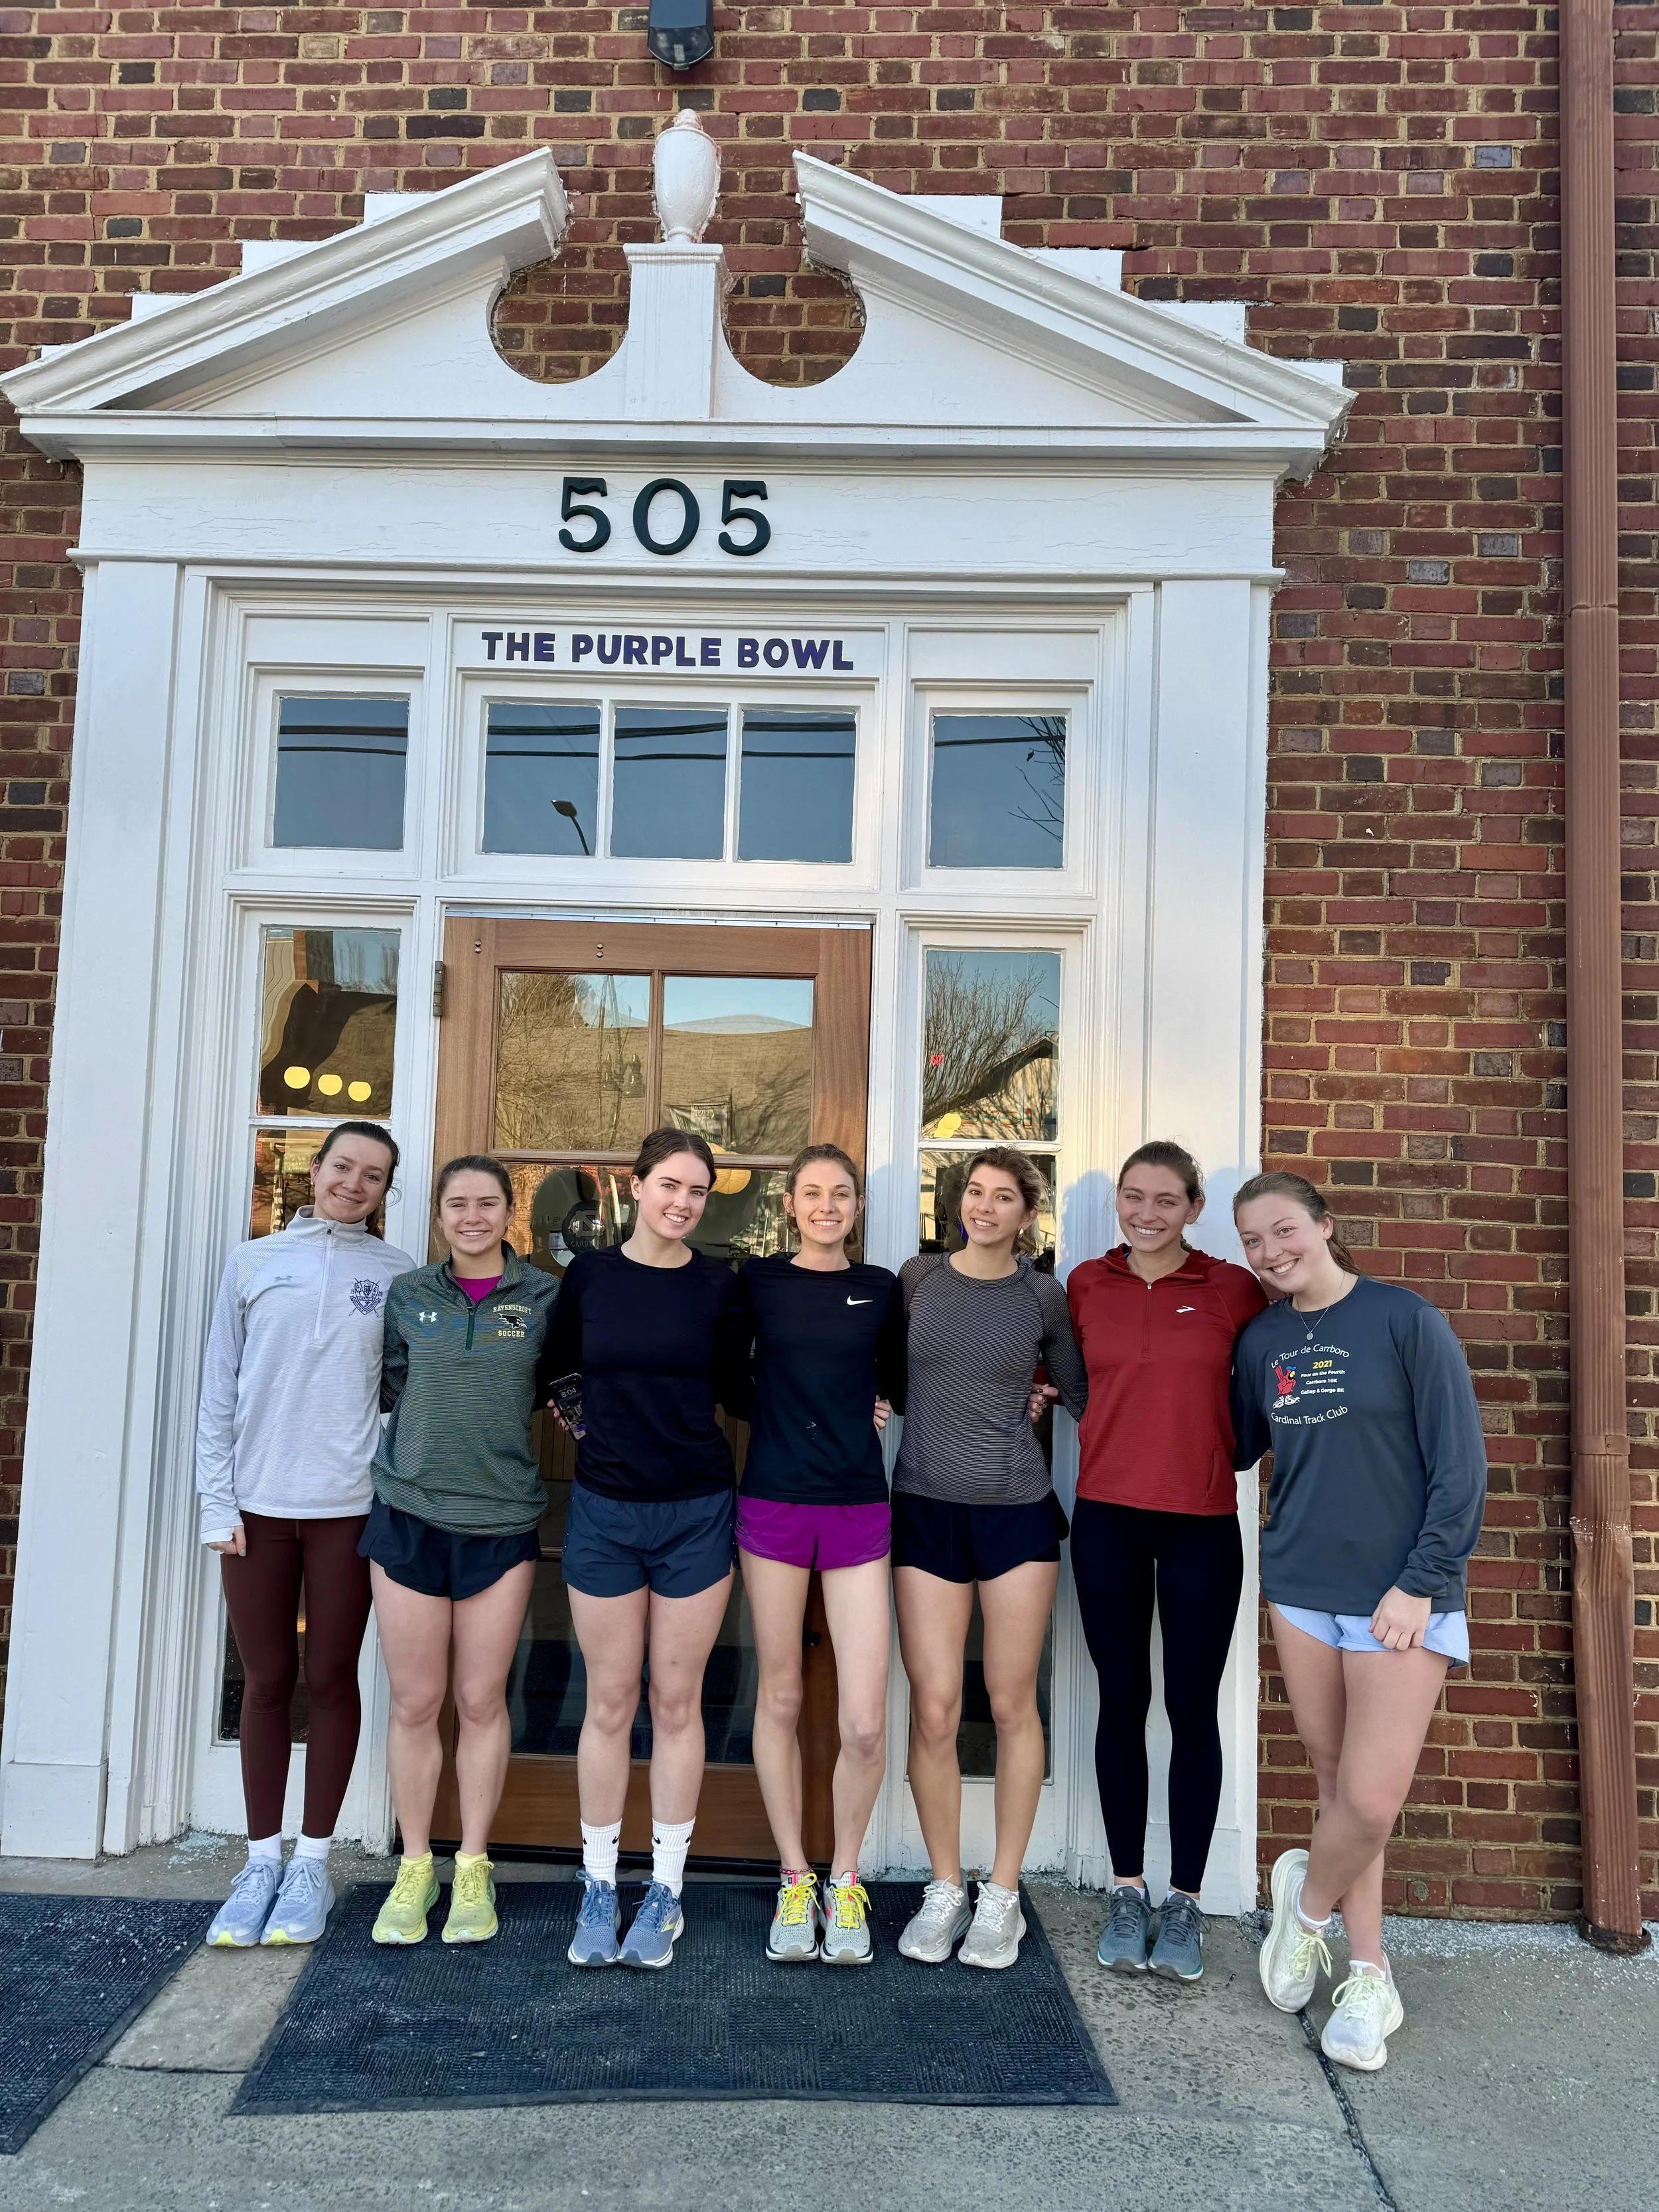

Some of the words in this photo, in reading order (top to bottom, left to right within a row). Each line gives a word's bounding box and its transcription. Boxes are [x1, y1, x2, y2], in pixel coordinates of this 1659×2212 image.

[558, 477, 771, 556] 505
[481, 631, 555, 662] THE
[571, 634, 722, 667] PURPLE
[737, 637, 854, 670] BOWL
[492, 1304, 532, 1315] RAVENSCROFT
[1271, 1359, 1279, 1369] Le
[1279, 1349, 1299, 1361] Tour
[1301, 1345, 1311, 1355] de
[1313, 1343, 1350, 1359] Carrboro
[1313, 1360, 1333, 1369] 2021
[561, 1387, 577, 1398] 8:04
[1271, 1412, 1302, 1425] Cardinal
[1303, 1414, 1326, 1425] Track
[1327, 1405, 1348, 1419] Club
